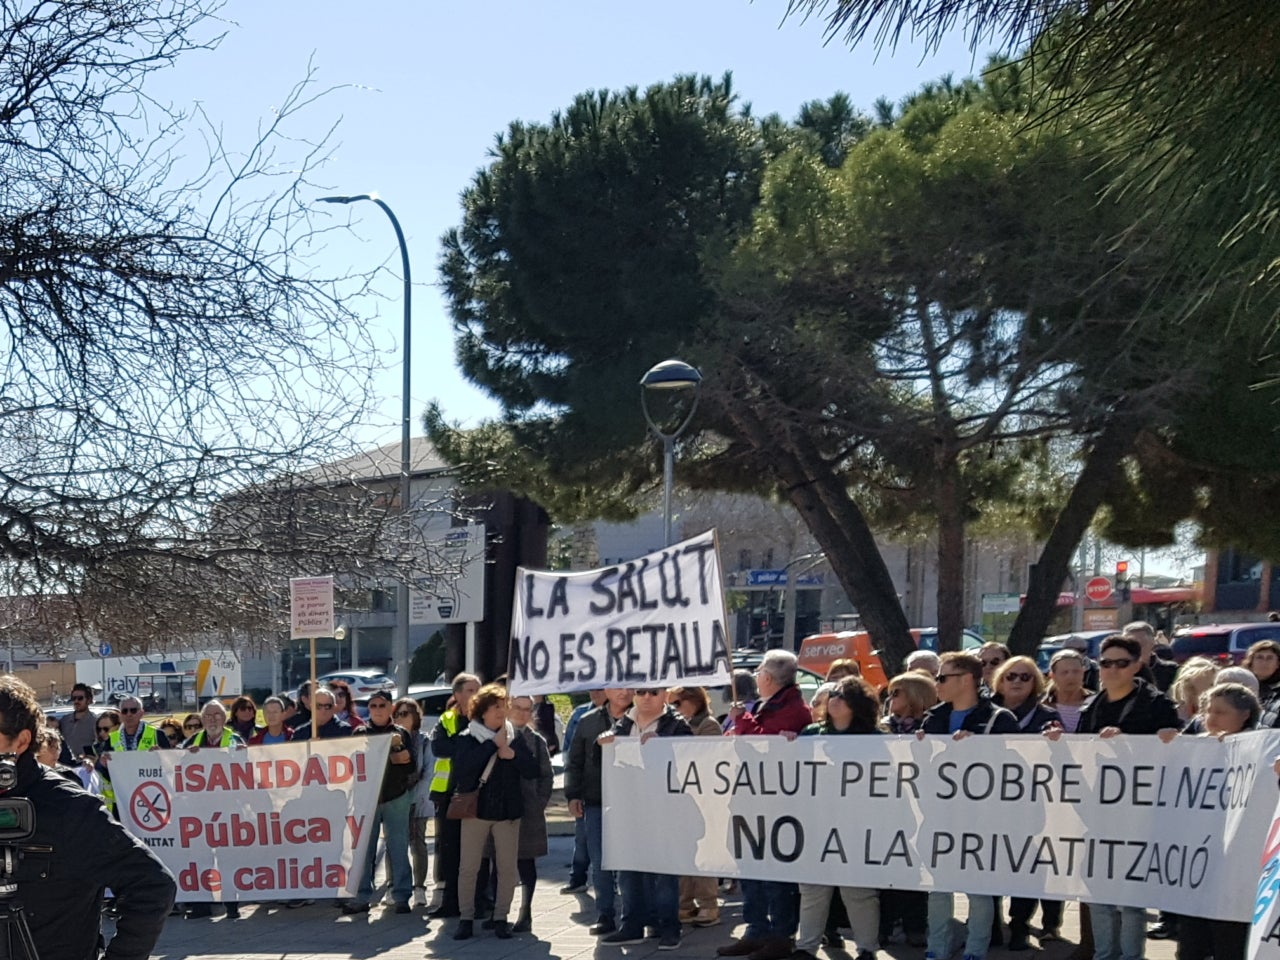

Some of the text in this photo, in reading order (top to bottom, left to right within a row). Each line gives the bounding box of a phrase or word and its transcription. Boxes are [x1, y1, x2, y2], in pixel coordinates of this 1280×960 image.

[526, 542, 715, 618] LA SALUT
[1087, 585, 1110, 594] STOP
[509, 619, 733, 683] NO ES RETALLA
[804, 644, 846, 658] serveo
[138, 766, 163, 778] RUBÍ
[174, 753, 367, 794] ¡SANIDAD!
[666, 760, 702, 795] LA
[713, 760, 827, 797] SALUT
[840, 760, 920, 799] PER
[936, 761, 1083, 804] SOBRE
[1099, 764, 1166, 808] DEL
[137, 836, 175, 848] NITAT
[179, 811, 365, 850] Pública y
[732, 815, 1211, 889] NO A LA PRIVATITZACIÓ
[178, 862, 222, 892] de
